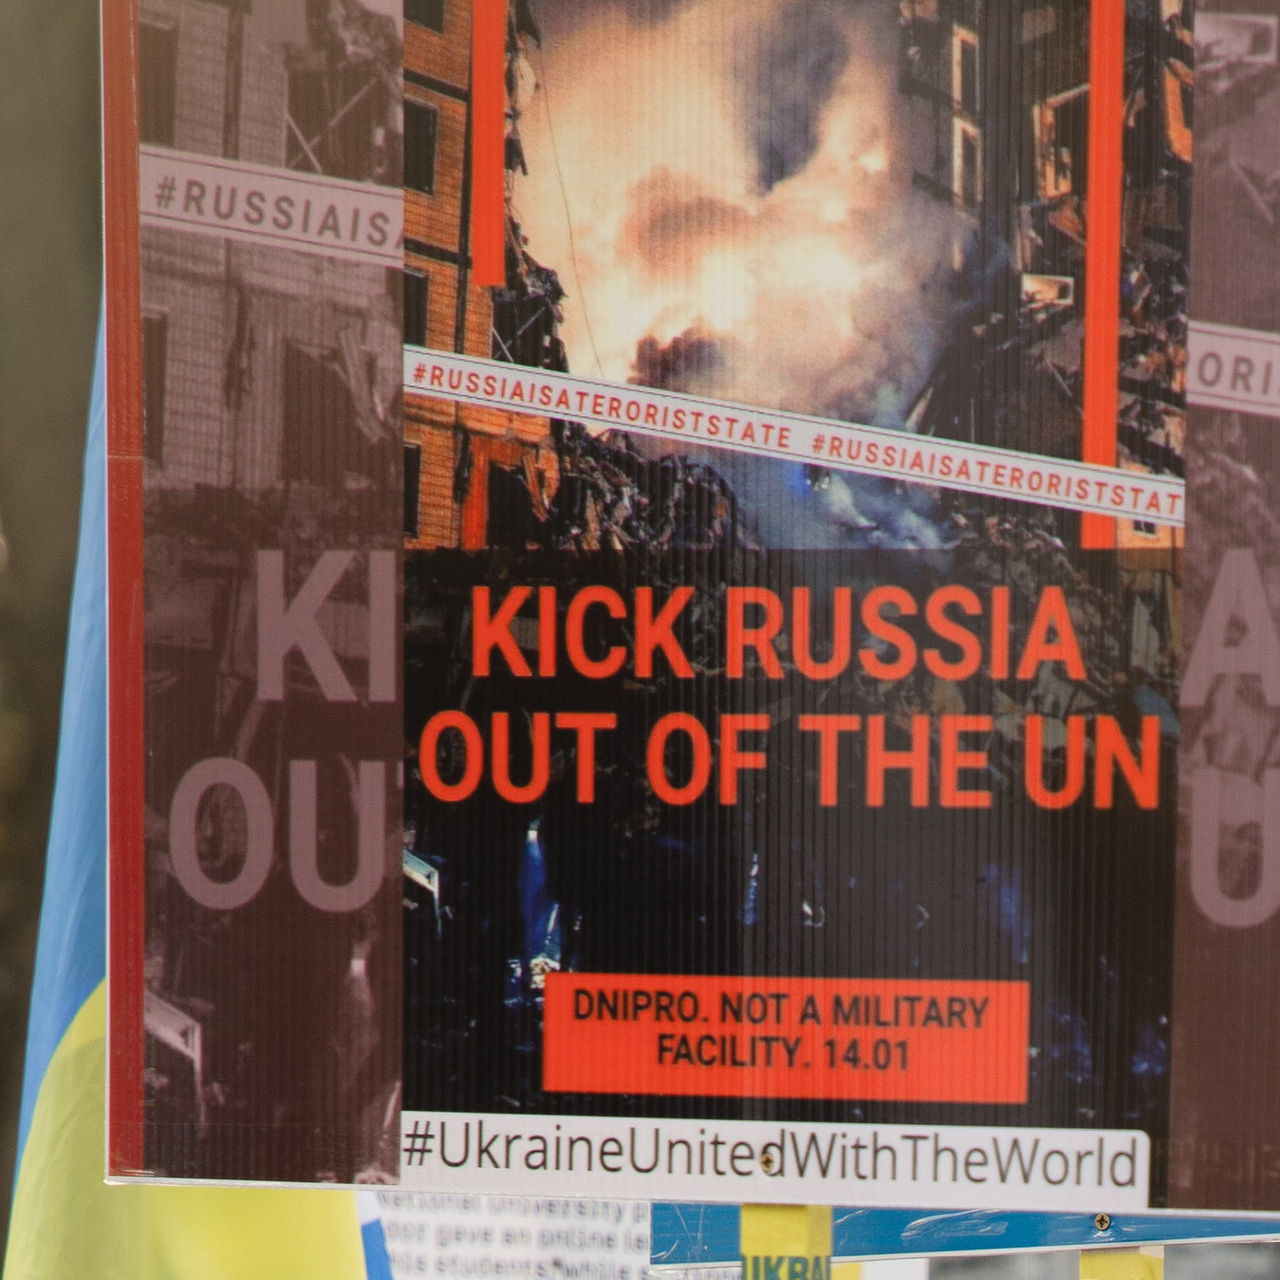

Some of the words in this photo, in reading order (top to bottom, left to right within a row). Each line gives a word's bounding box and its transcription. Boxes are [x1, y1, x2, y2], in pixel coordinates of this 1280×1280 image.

[154, 175, 403, 249] #RUSSIAIS
[414, 363, 792, 448] #RUSSIAISATERORISTSTATE
[812, 433, 1182, 516] #RUSSIAISATERORISTSTAT
[472, 585, 695, 679] KICK
[726, 584, 1087, 682] RUSSIA
[419, 710, 617, 804] OUT
[646, 711, 771, 805] OF
[799, 714, 993, 808] THE
[1023, 715, 1160, 810] UN
[169, 757, 403, 913] OU
[573, 989, 709, 1024] DNIPRO.
[721, 992, 786, 1025] NOT
[801, 995, 822, 1027] A
[833, 995, 988, 1031] MILITARY
[657, 1034, 811, 1070] FACILITY.
[826, 1039, 909, 1072] 14.01
[403, 1119, 1136, 1188] #UkraineUnitedWithTheWorld
